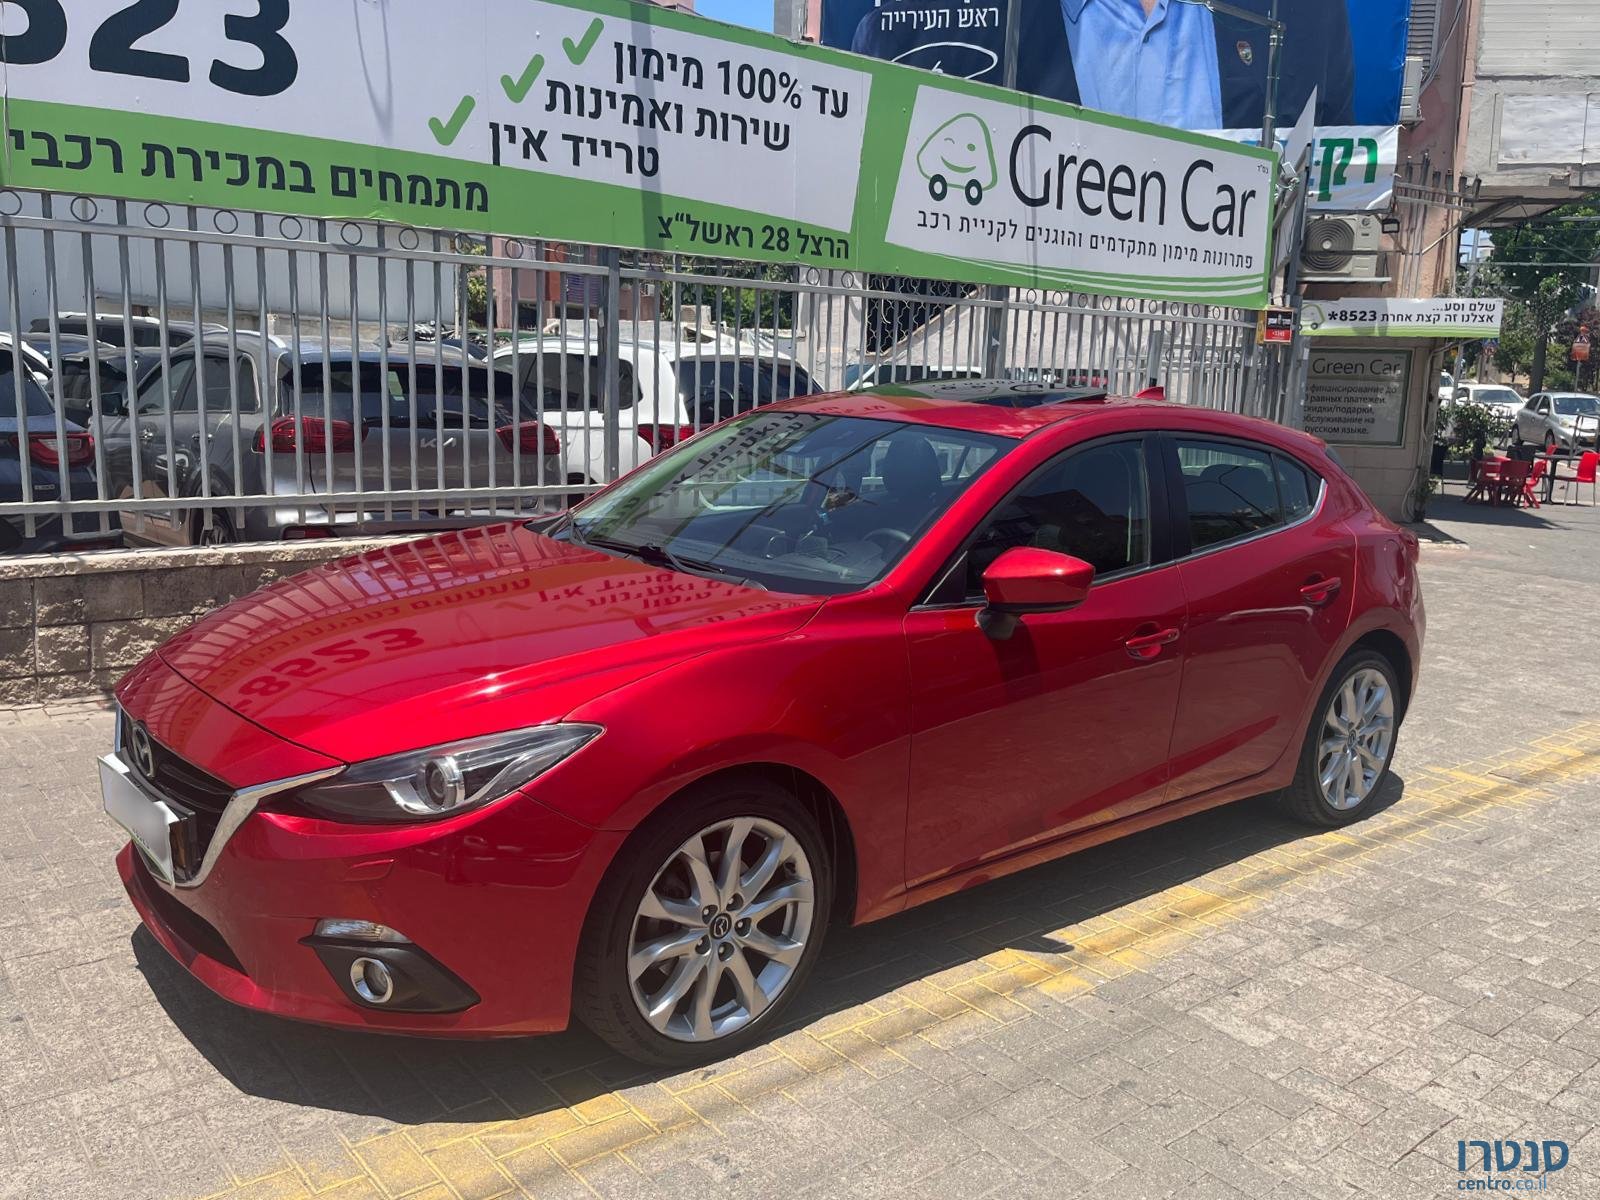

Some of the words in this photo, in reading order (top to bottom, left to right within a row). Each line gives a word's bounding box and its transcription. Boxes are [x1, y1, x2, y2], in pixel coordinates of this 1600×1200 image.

[880, 8, 950, 31] העירייה
[956, 7, 999, 28] ראש
[614, 41, 704, 90] מימון
[718, 60, 802, 109] 100%
[545, 79, 683, 134] ואמינות
[811, 84, 849, 119] עד
[694, 107, 790, 152] שירות
[489, 121, 548, 167] אין
[561, 133, 659, 178] טרייד
[140, 142, 316, 194] במכירת
[330, 164, 489, 213] מתמחים
[1008, 124, 1168, 227] Green
[1180, 159, 1257, 238] Car
[917, 210, 950, 231] רכב
[959, 215, 1018, 241] לקניית
[762, 224, 790, 253] 28
[796, 227, 849, 260] הרצל
[1025, 225, 1083, 248] והוגנים
[1089, 234, 1157, 259] מתקדמים
[1162, 243, 1198, 264] מימון
[1202, 247, 1254, 270] פתרונות
[1380, 313, 1412, 322] אחרת
[1416, 313, 1440, 324] קצת
[1444, 313, 1457, 323] זה
[1461, 313, 1494, 323] אצלנו
[1468, 302, 1495, 312] שלם
[1312, 357, 1365, 375] Green
[1369, 358, 1401, 375] Car
